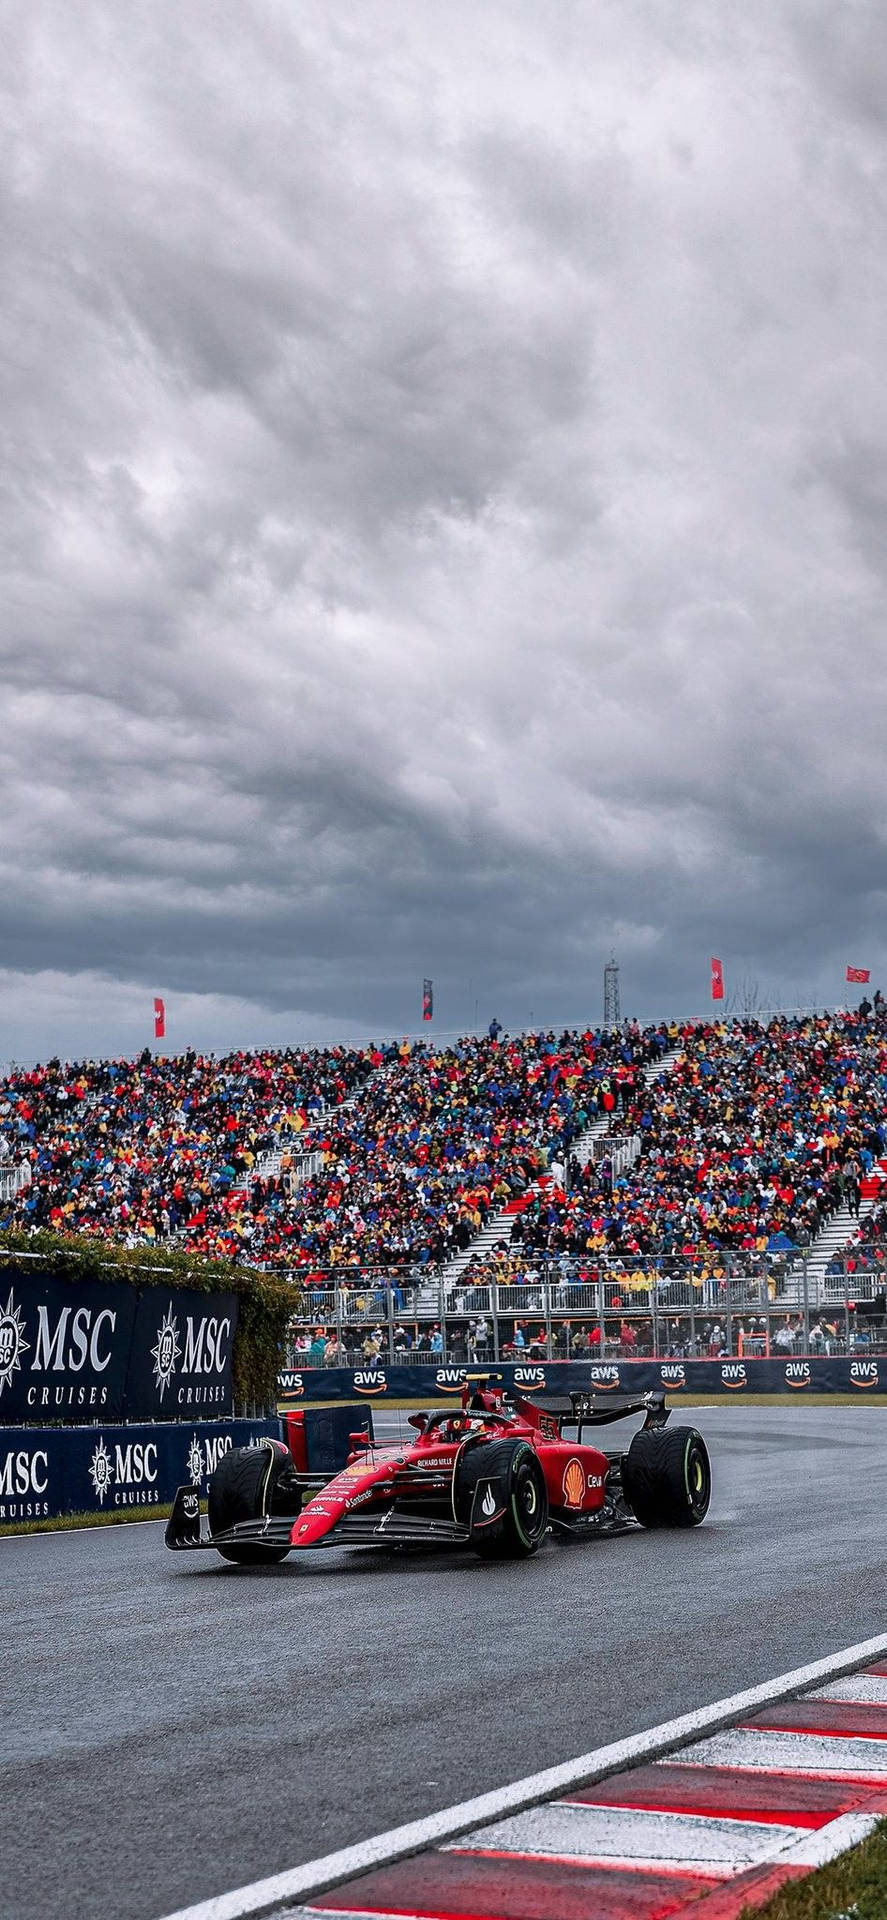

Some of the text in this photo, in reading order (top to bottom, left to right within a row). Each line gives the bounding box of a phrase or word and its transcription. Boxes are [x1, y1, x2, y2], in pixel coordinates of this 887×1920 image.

[30, 1305, 117, 1372] MSC
[180, 1317, 231, 1374] MSC
[354, 1370, 386, 1384] aws
[436, 1367, 467, 1382] aws
[514, 1366, 545, 1381] aws
[591, 1365, 619, 1379] aws
[661, 1364, 685, 1378] aws
[721, 1363, 746, 1378] aws
[785, 1362, 810, 1377] aws
[850, 1362, 878, 1376] aws
[27, 1386, 108, 1405] CRUISES
[177, 1386, 225, 1404] CRUISES
[114, 1444, 158, 1484] MSC
[114, 1490, 159, 1505] CRUISES
[183, 1493, 199, 1508] aws
[0, 1502, 49, 1518] RUISES
